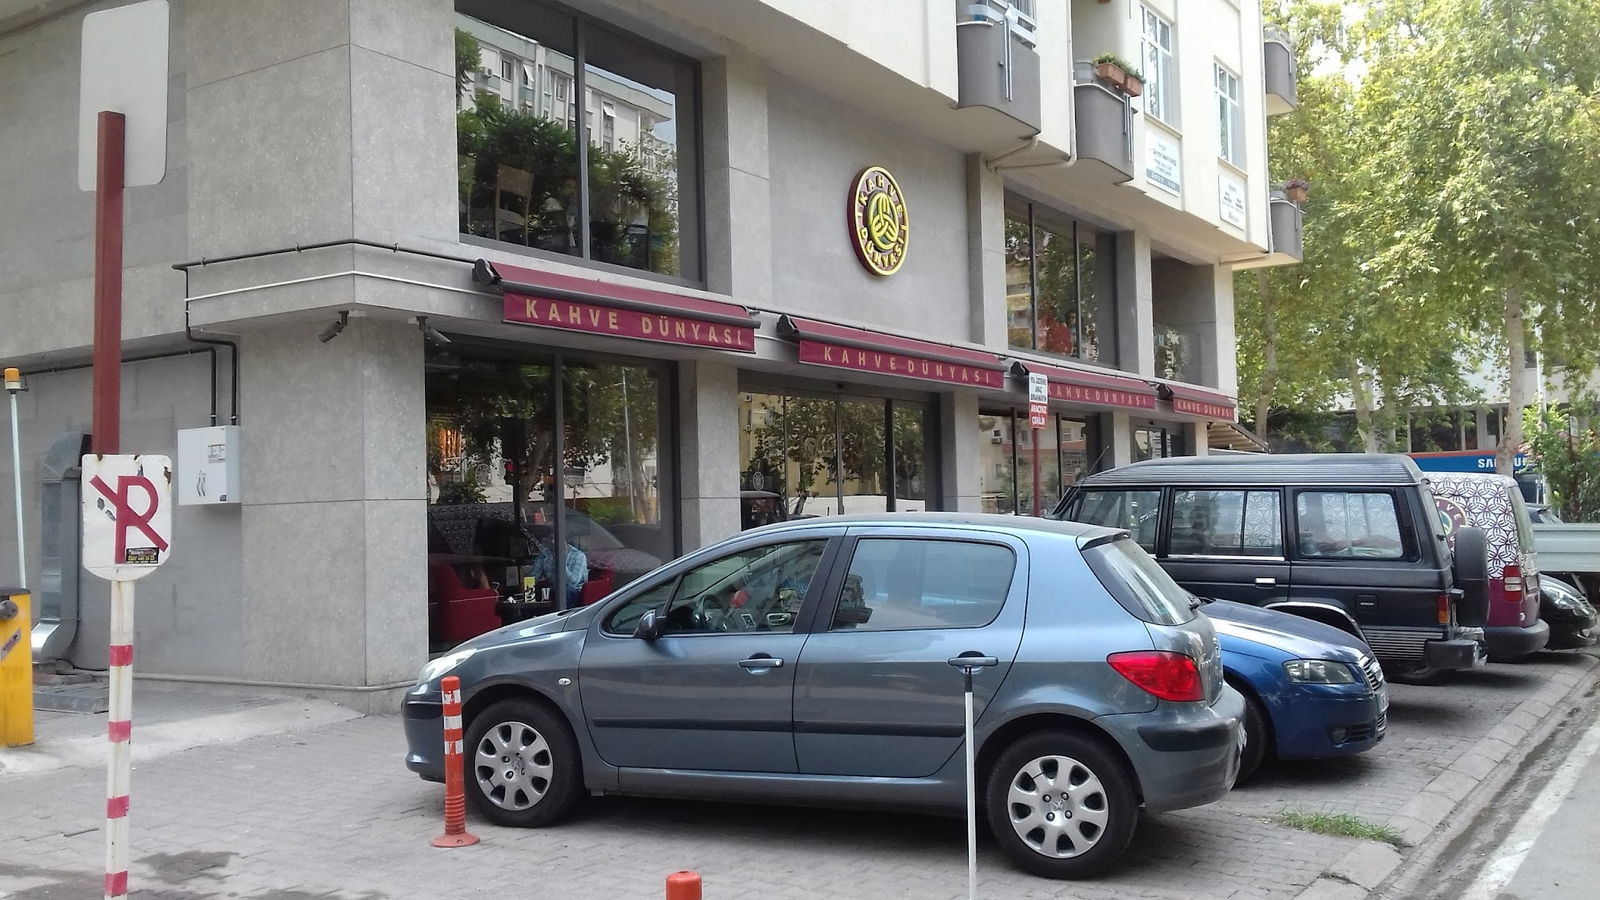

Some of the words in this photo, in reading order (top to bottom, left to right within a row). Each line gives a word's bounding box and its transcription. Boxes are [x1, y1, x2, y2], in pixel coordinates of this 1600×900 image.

[858, 175, 904, 214] KAHVE
[525, 298, 619, 330] KAHVE
[641, 315, 742, 346] DÜNYASI
[823, 346, 897, 371] KAHVE
[907, 359, 990, 384] DÜNYASI
[1095, 388, 1146, 408] DÜNYASI
[1177, 400, 1200, 413] KAHVE
